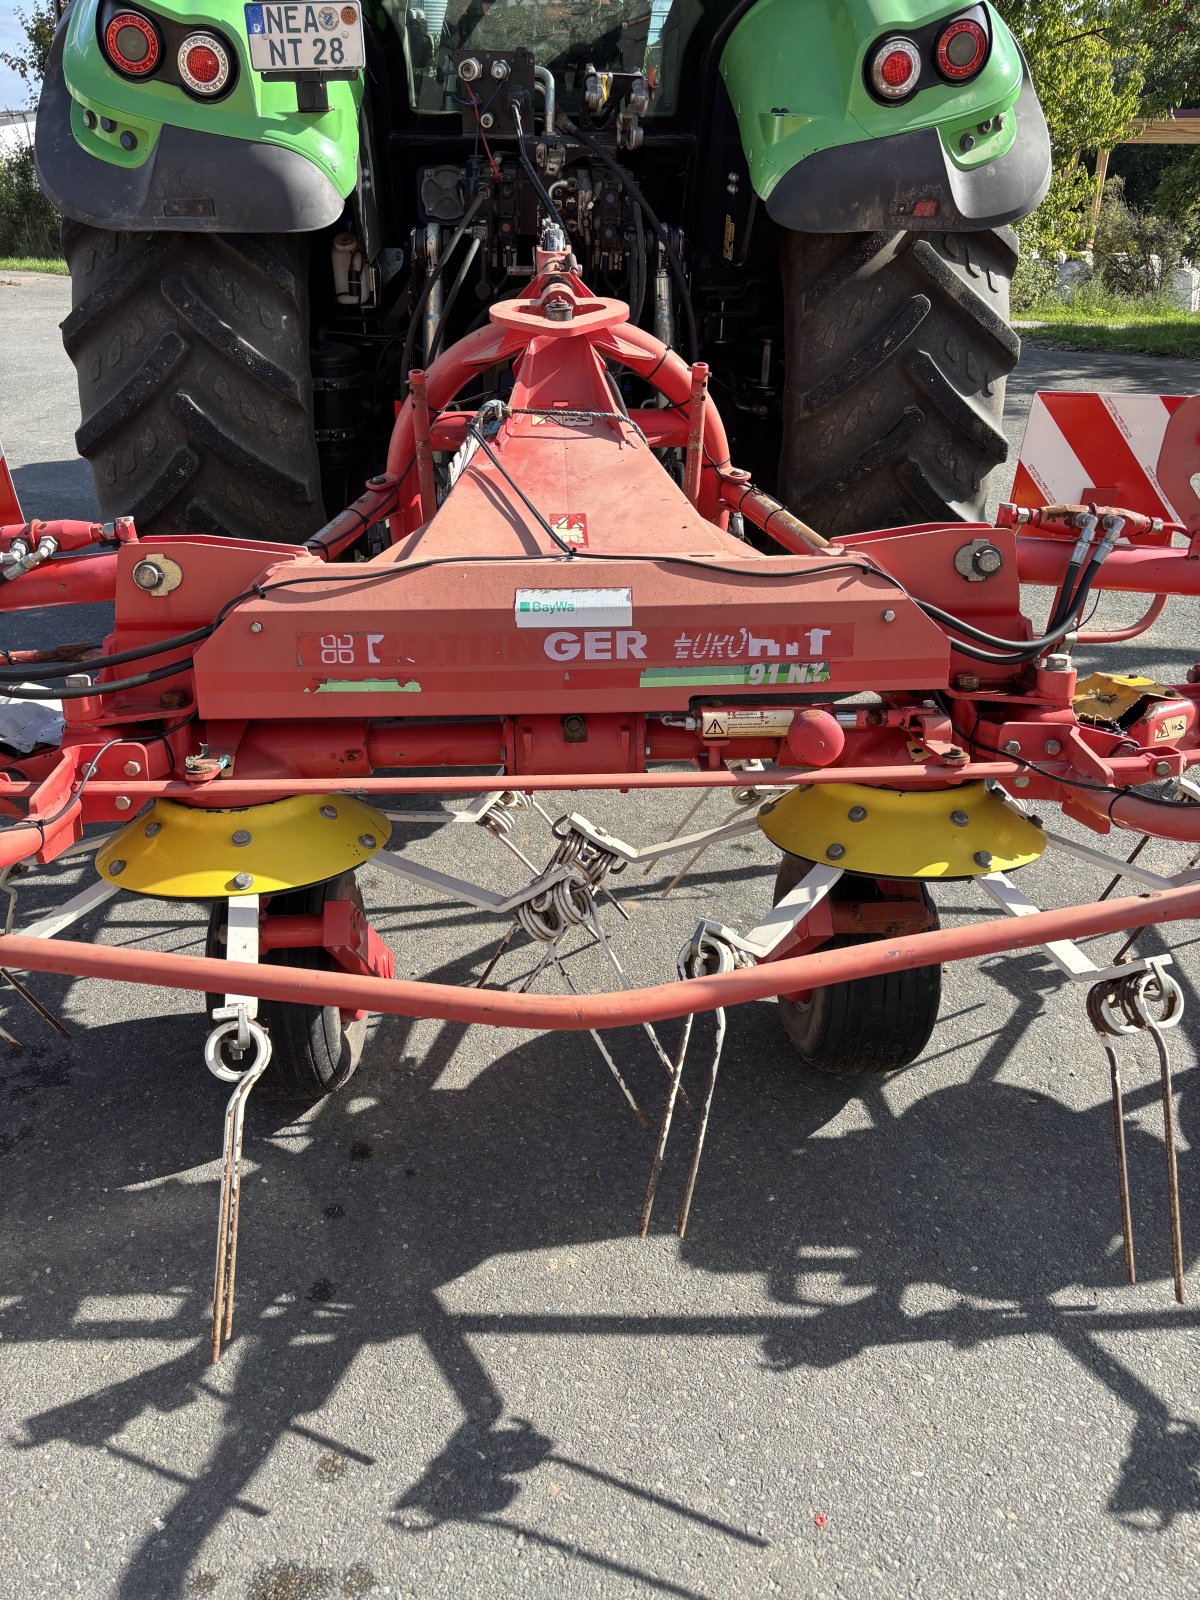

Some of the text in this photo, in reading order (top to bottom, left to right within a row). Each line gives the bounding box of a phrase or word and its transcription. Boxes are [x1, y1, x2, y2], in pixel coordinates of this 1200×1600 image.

[253, 24, 261, 32] D
[266, 6, 319, 33] NEA
[269, 38, 345, 66] NT 28
[532, 601, 575, 614] BayWa
[748, 663, 780, 686] 91
